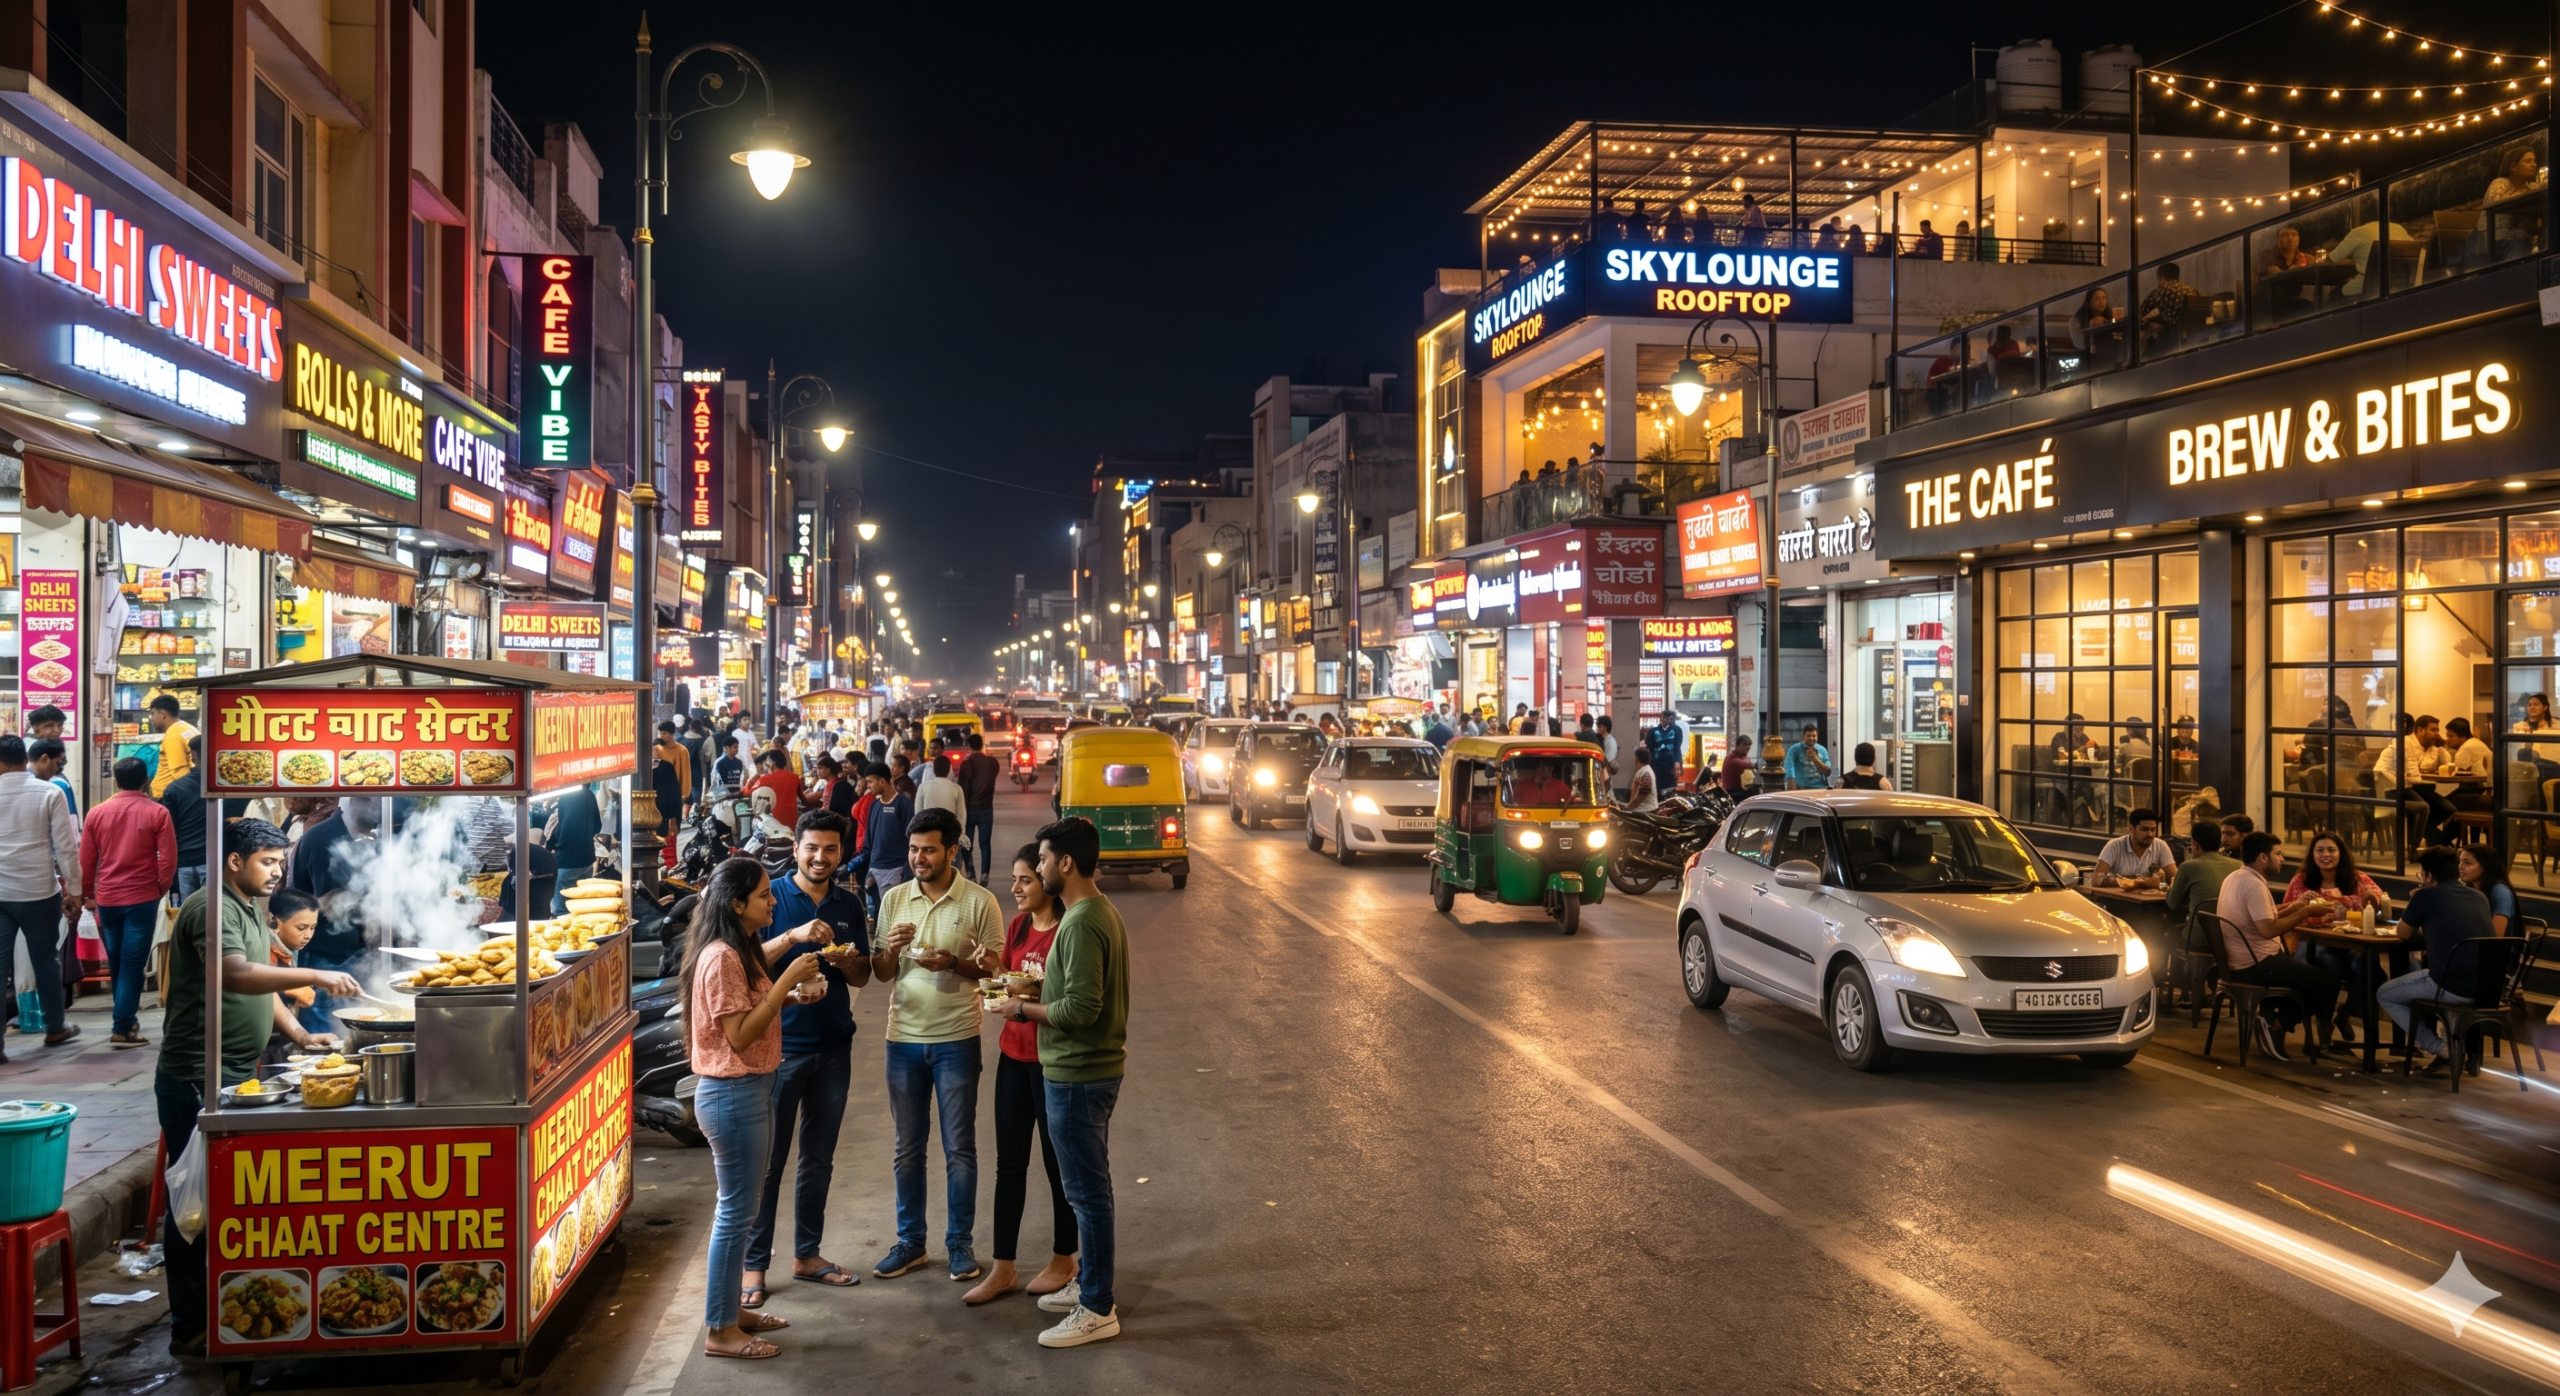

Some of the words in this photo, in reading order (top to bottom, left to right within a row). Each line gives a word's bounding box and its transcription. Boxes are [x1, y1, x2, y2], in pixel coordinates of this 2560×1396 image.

[5, 157, 144, 316] DELHI
[149, 244, 283, 382] SWEETS
[1474, 260, 1566, 344] SKYLOUNGE
[1606, 249, 1839, 288] SKYLOUNGE
[1656, 289, 1790, 314] ROOFTOP
[1492, 313, 1543, 358] ROOFTOP
[297, 343, 358, 431] ROLLS
[362, 379, 375, 440] &
[379, 387, 423, 462] MORE
[541, 364, 572, 461] VIBE
[693, 387, 711, 455] TASTY
[2169, 407, 2292, 486] BREW
[2304, 400, 2341, 463] &
[2356, 363, 2512, 455] BITES
[435, 416, 474, 477] CAFE
[476, 438, 506, 493] VIBE
[1905, 473, 1961, 529] THE
[1969, 438, 2054, 519] CAFÉ
[30, 582, 71, 596] DELHI
[501, 615, 547, 633] DELHI
[550, 616, 601, 635] SWEETS
[415, 697, 514, 743] सेन्टर
[534, 1081, 592, 1183] MEERUT
[595, 1043, 631, 1120] CHAAT
[233, 1142, 493, 1206] MEERUT
[536, 1149, 581, 1231] CHAAT
[583, 1098, 627, 1179] CENTRE
[218, 1213, 345, 1261] CHAAT
[355, 1207, 506, 1256] CENTRE
